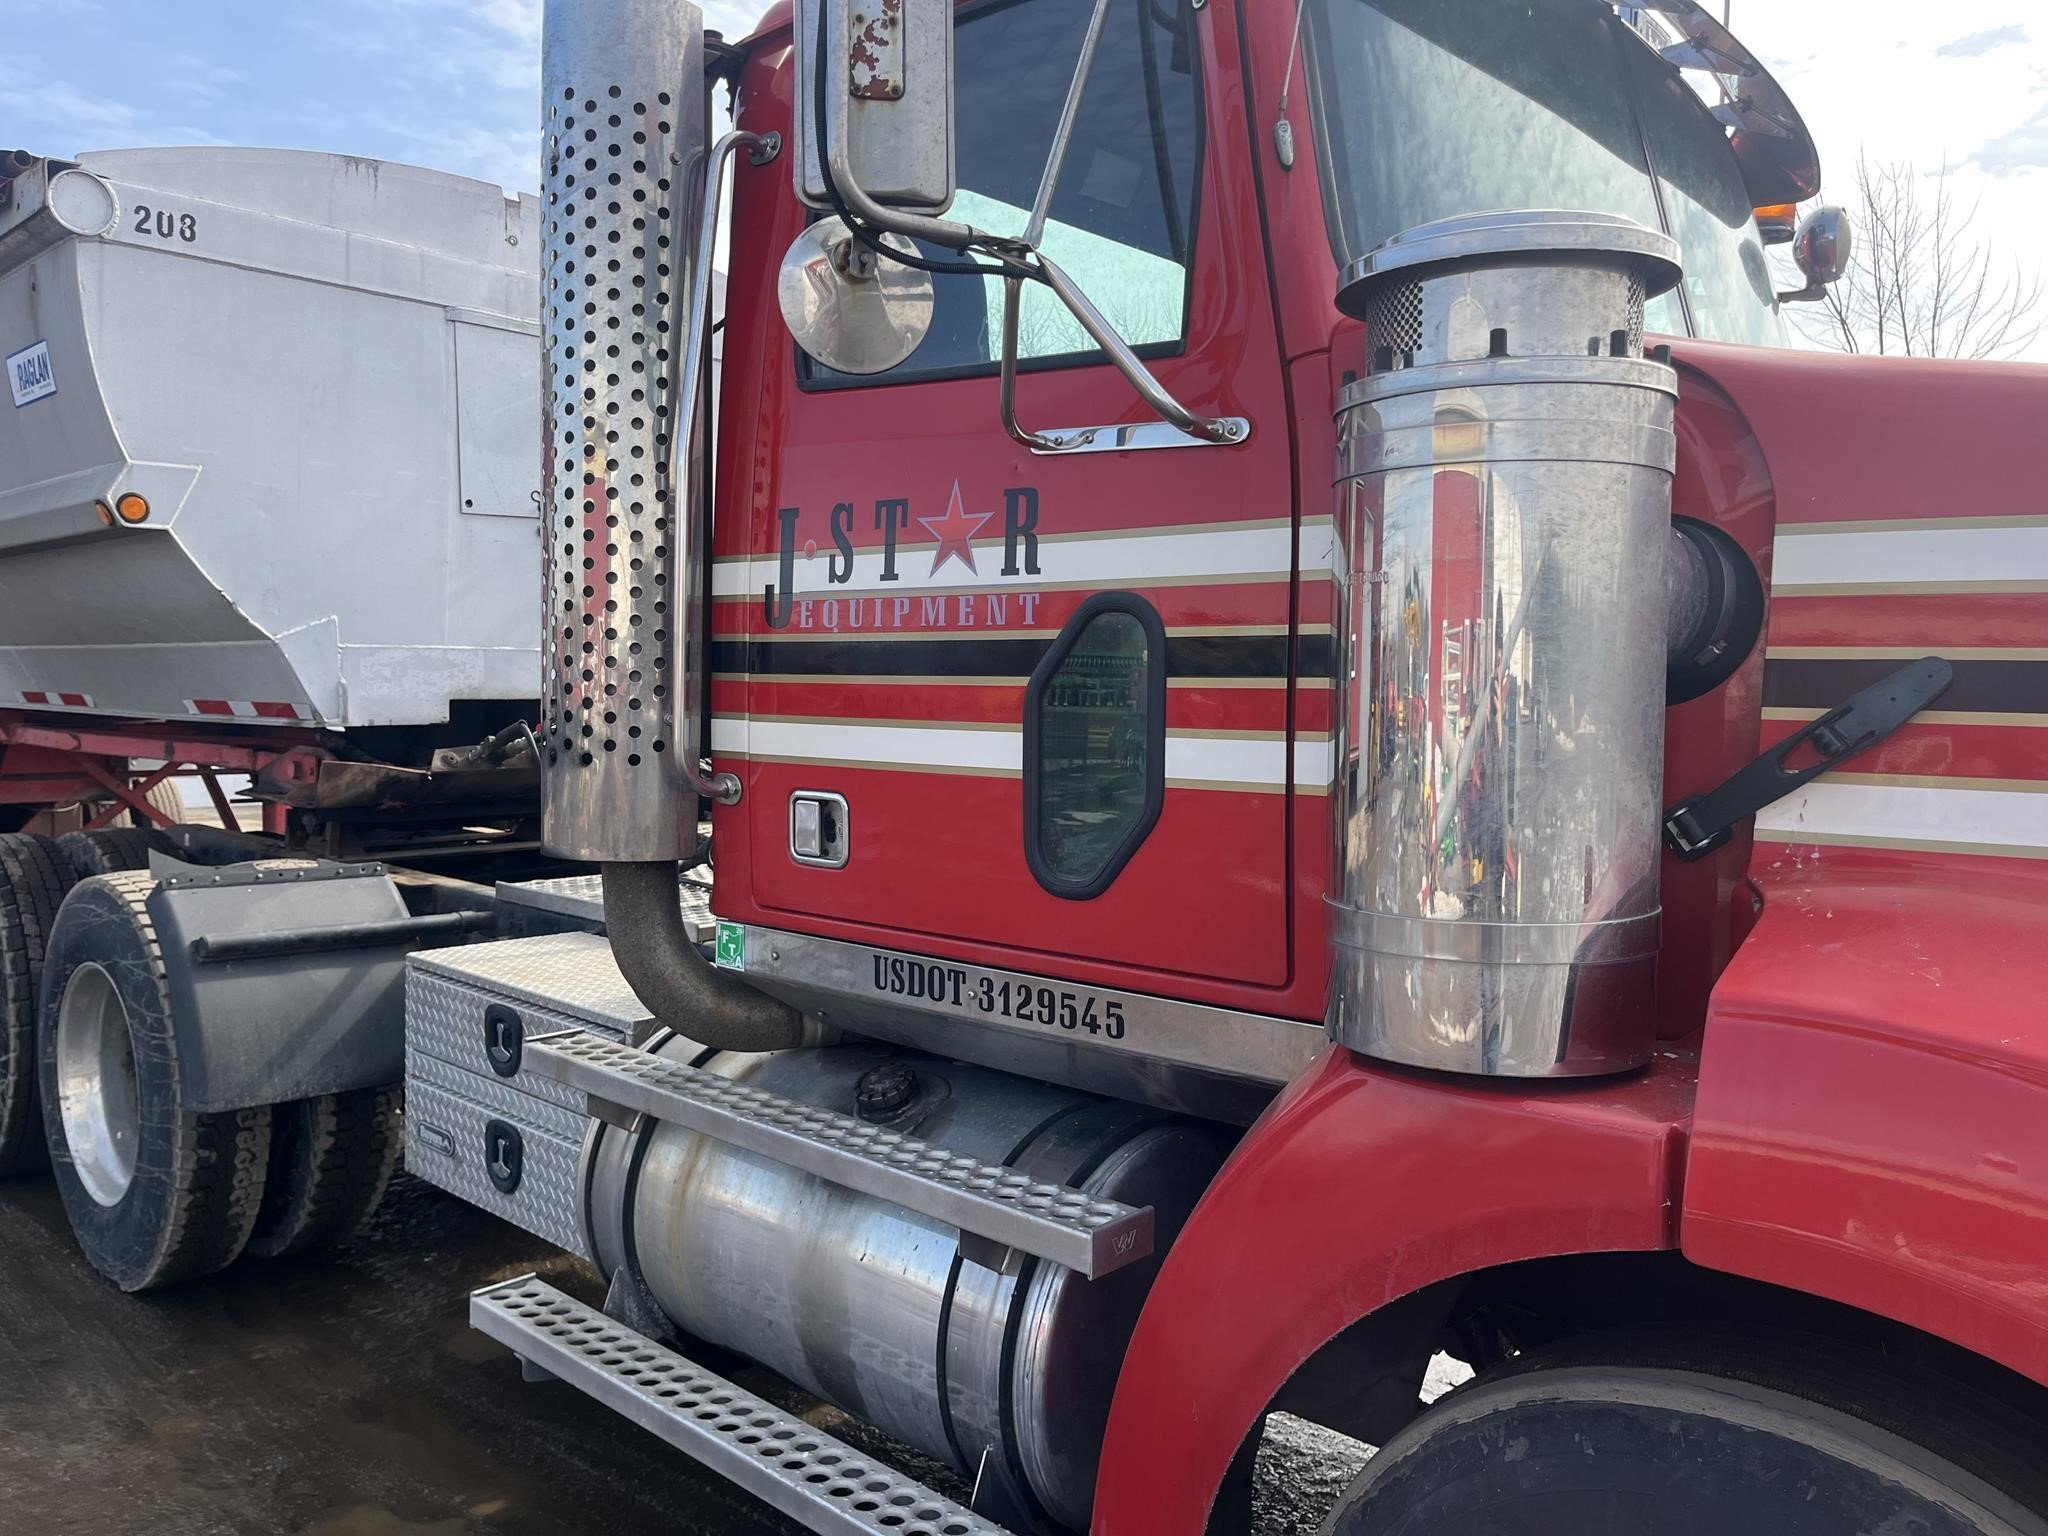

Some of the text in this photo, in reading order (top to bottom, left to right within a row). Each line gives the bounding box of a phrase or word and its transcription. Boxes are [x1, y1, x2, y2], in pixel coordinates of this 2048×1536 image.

[17, 351, 50, 391] RAGLAN
[799, 593, 1040, 633] EQUIPMENT
[873, 954, 1125, 1040] USDOT 3129545
